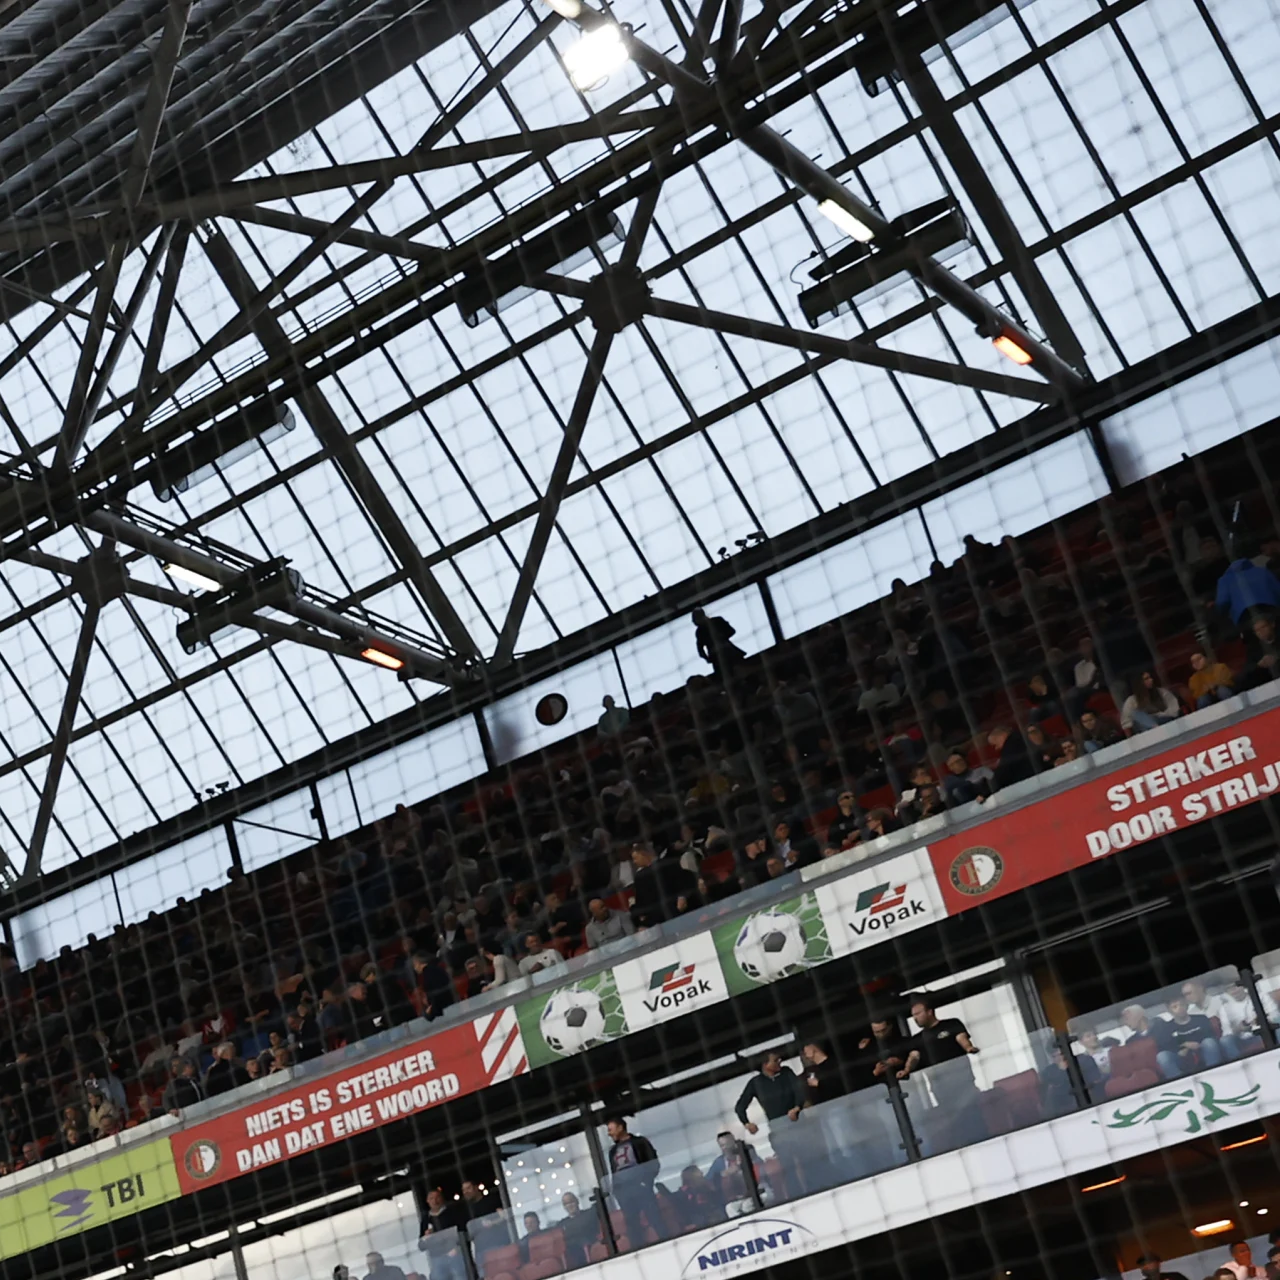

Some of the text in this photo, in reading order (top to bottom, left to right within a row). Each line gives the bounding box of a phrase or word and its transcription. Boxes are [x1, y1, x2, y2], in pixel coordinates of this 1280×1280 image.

[1106, 735, 1257, 812] STERKER
[1085, 805, 1178, 859] DOOR
[849, 898, 927, 937] Vopak
[643, 978, 713, 1013] Vopak
[244, 1049, 437, 1138] NIETS IS STERKER
[236, 1143, 282, 1173] DAN
[286, 1125, 326, 1158] DAT
[330, 1108, 375, 1140] ENE
[376, 1072, 461, 1122] WOORD
[100, 1174, 146, 1208] TBI
[697, 1228, 793, 1271] NIRINT
